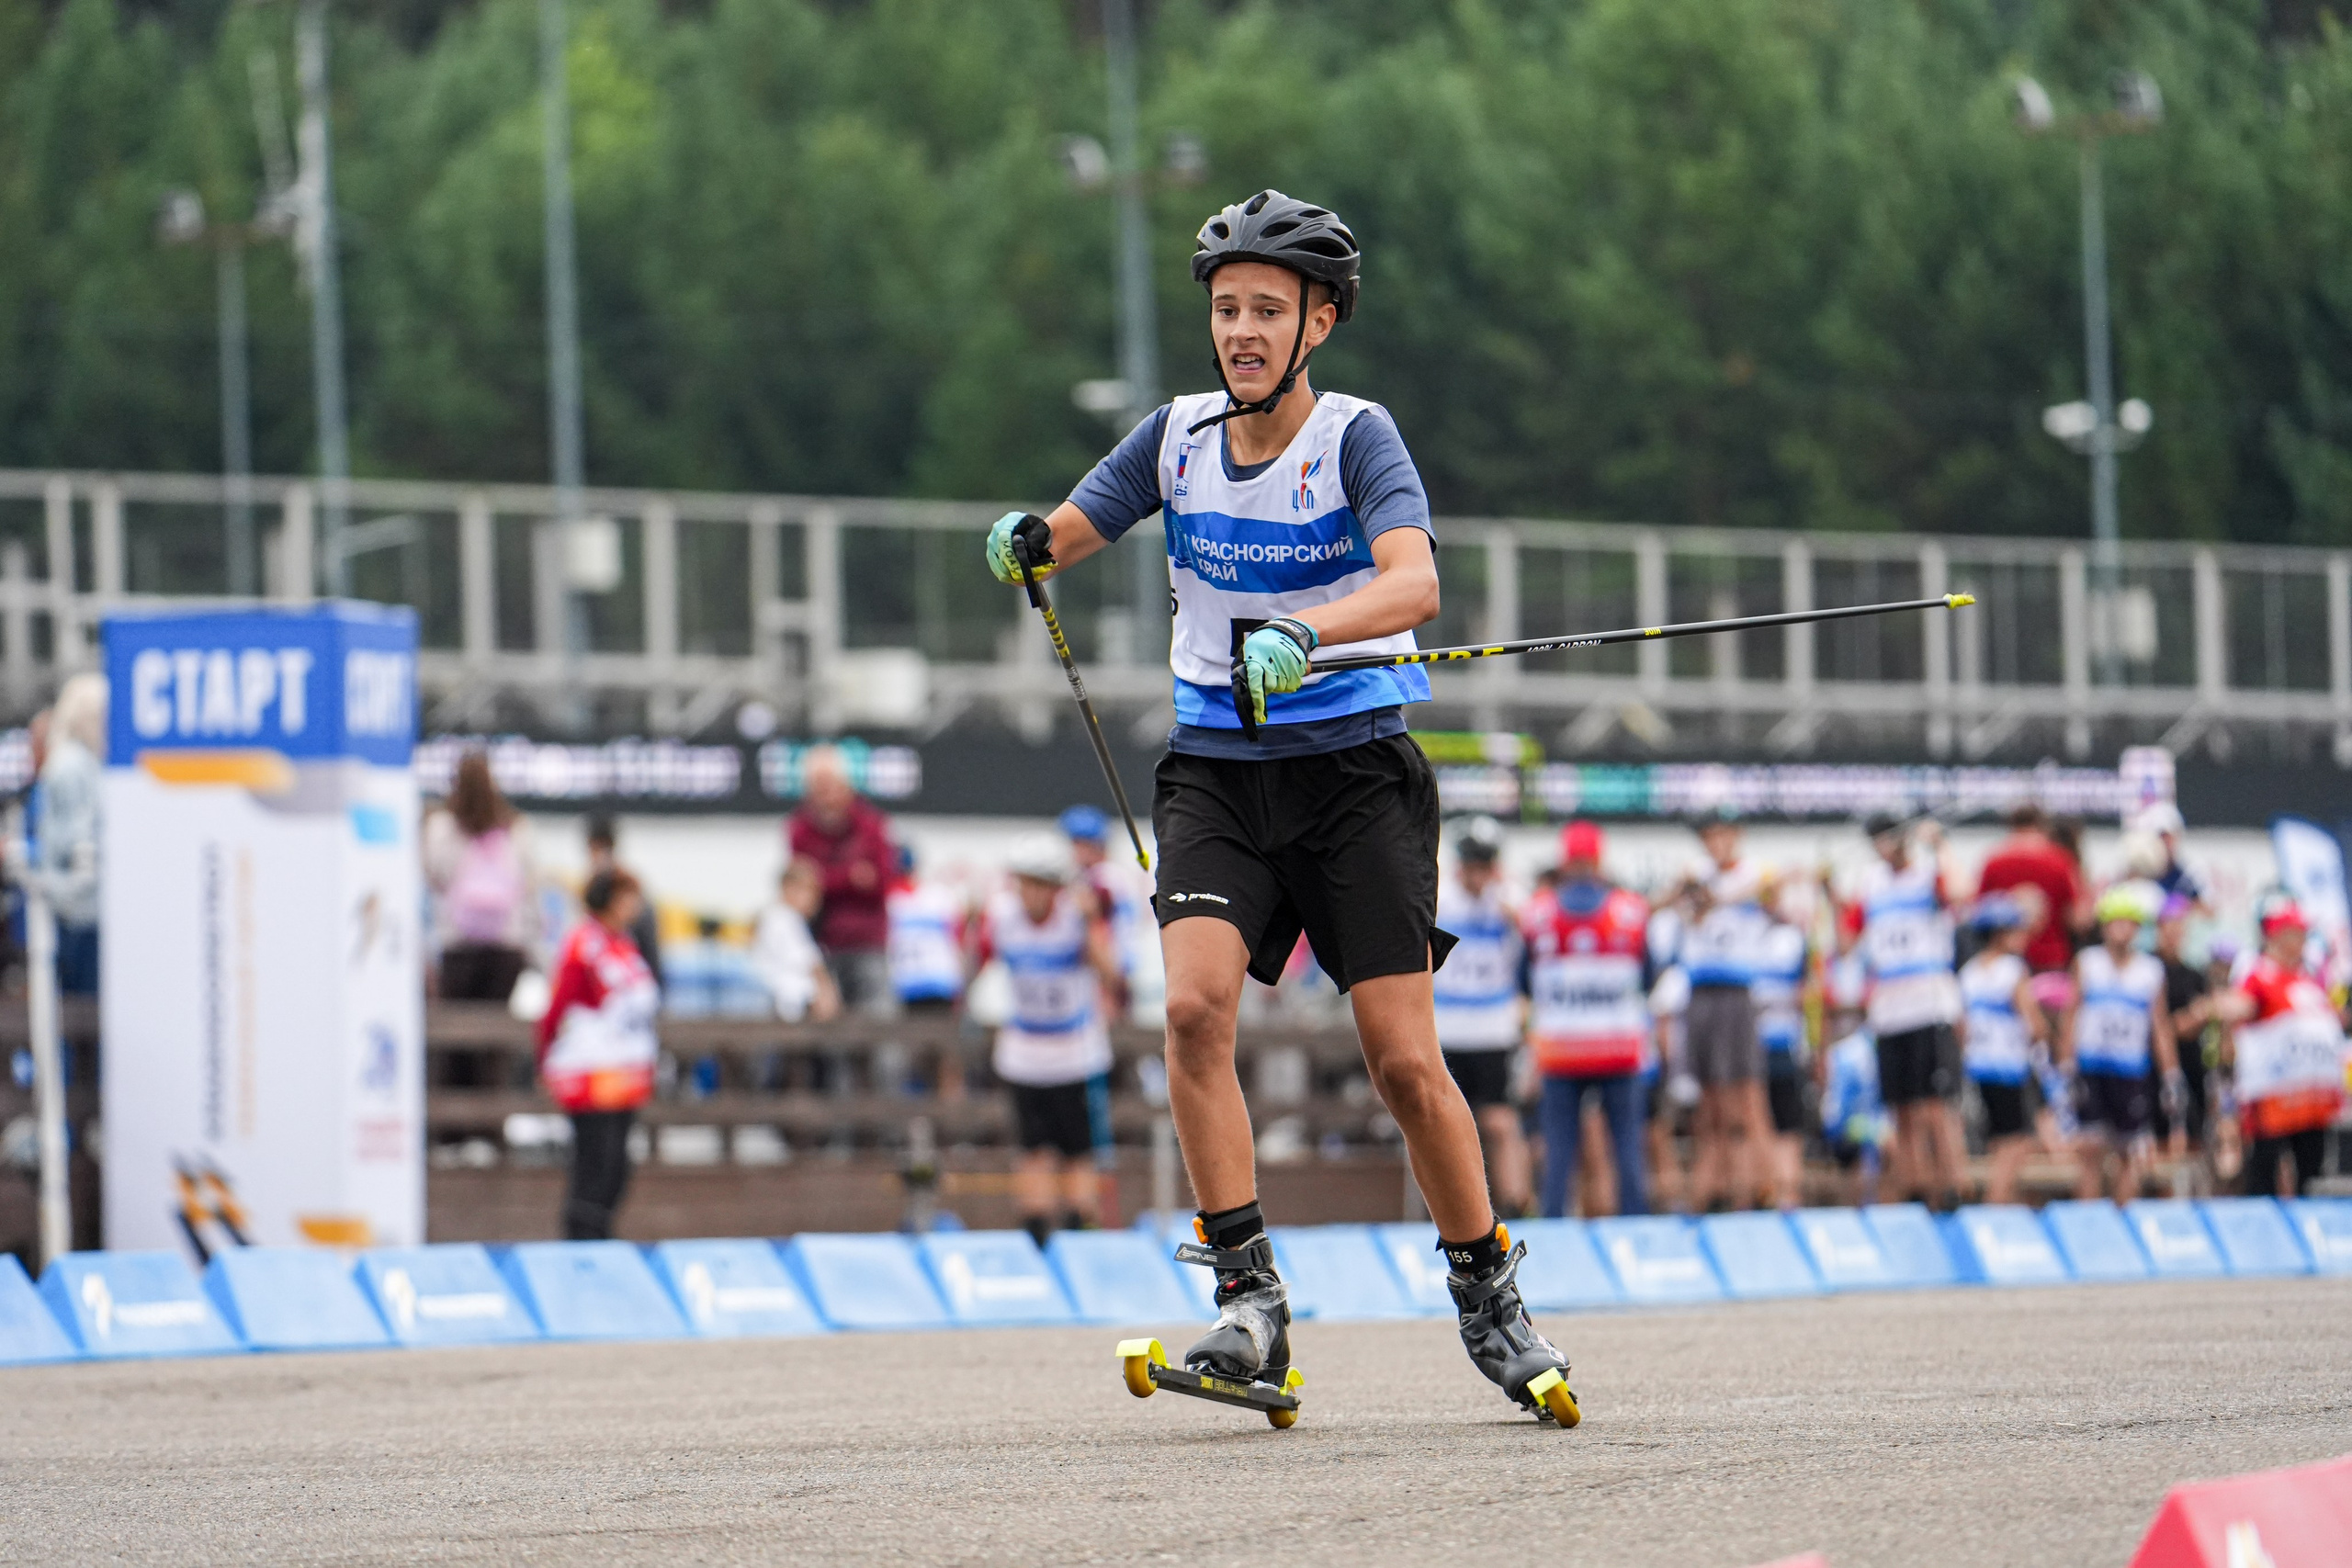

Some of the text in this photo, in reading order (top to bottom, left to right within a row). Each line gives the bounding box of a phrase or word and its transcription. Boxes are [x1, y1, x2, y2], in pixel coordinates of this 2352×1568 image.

[1192, 535, 1353, 562] КРАСНОЯРСКИЙ
[1196, 555, 1238, 581] КРАЙ
[131, 648, 313, 737] СТАРТ
[1449, 1250, 1473, 1263] 155
